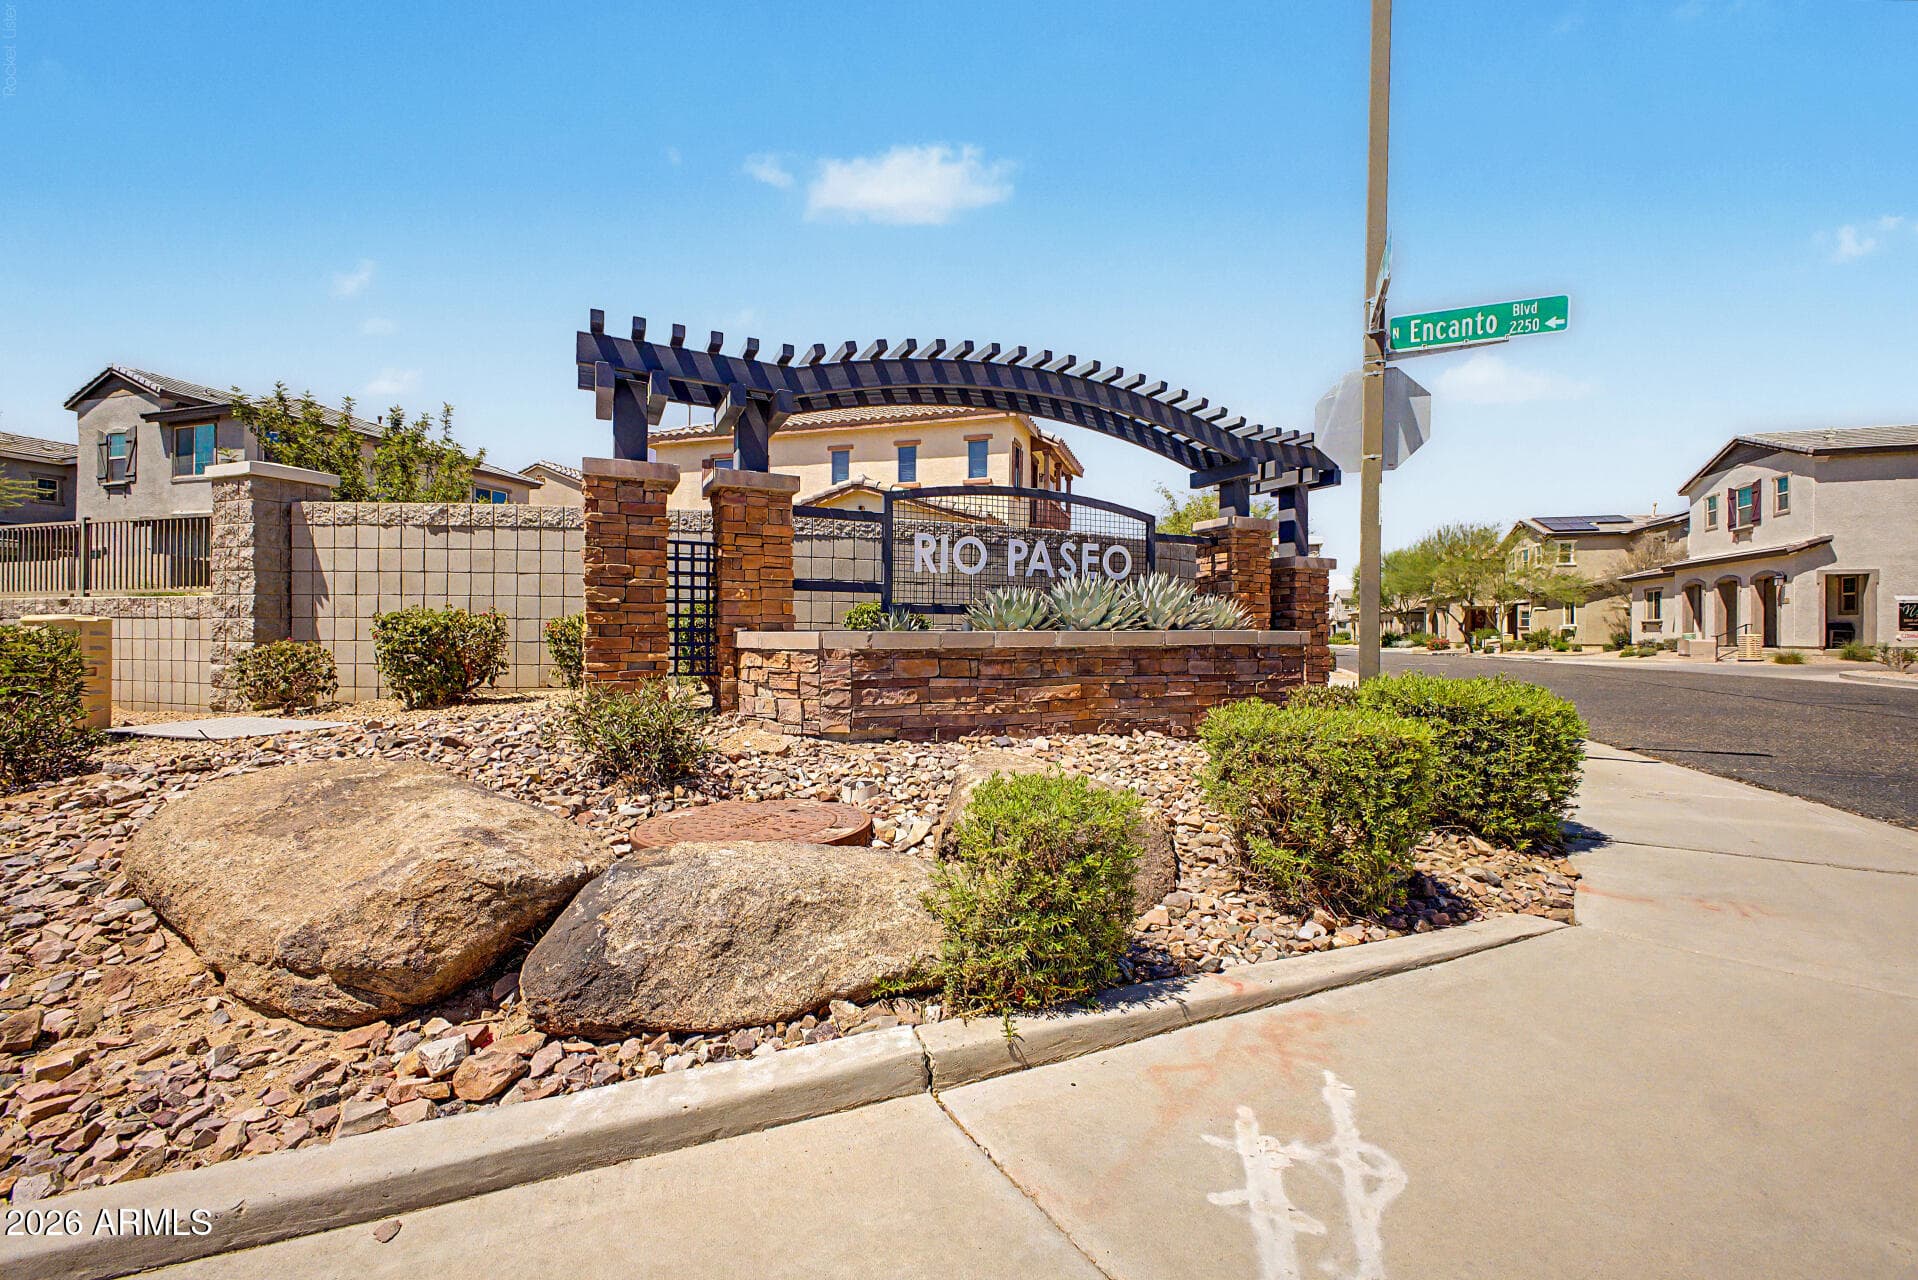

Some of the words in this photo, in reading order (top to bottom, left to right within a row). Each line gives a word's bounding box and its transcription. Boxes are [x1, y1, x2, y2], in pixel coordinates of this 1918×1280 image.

[1392, 327, 1400, 339] N
[1410, 311, 1498, 343] Encanto
[1512, 301, 1538, 317] Blvd
[1509, 318, 1540, 334] 2250
[914, 532, 988, 575] RIO
[1008, 538, 1132, 581] PASEO
